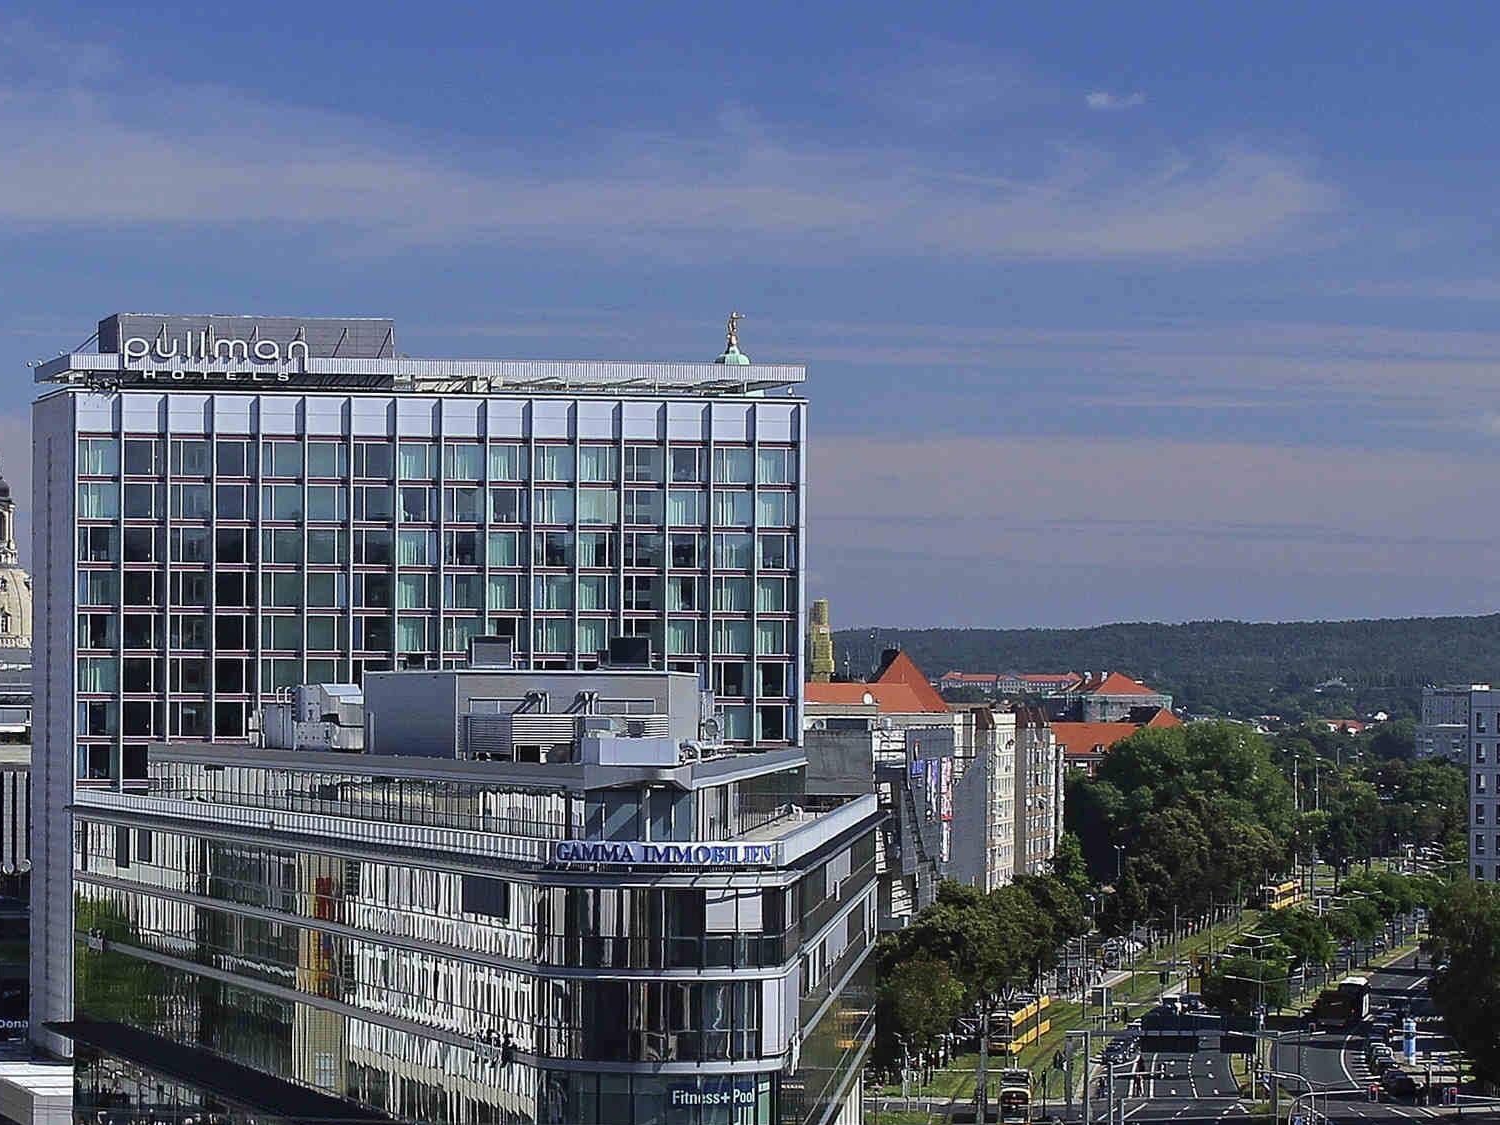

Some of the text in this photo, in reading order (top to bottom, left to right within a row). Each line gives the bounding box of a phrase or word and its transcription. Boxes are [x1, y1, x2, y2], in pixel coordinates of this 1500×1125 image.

[123, 331, 309, 372] pullman
[143, 369, 290, 382] HOTELS
[556, 842, 772, 864] GAMMA IMMOBILIEN
[672, 1088, 755, 1105] Fitness+ Pool
